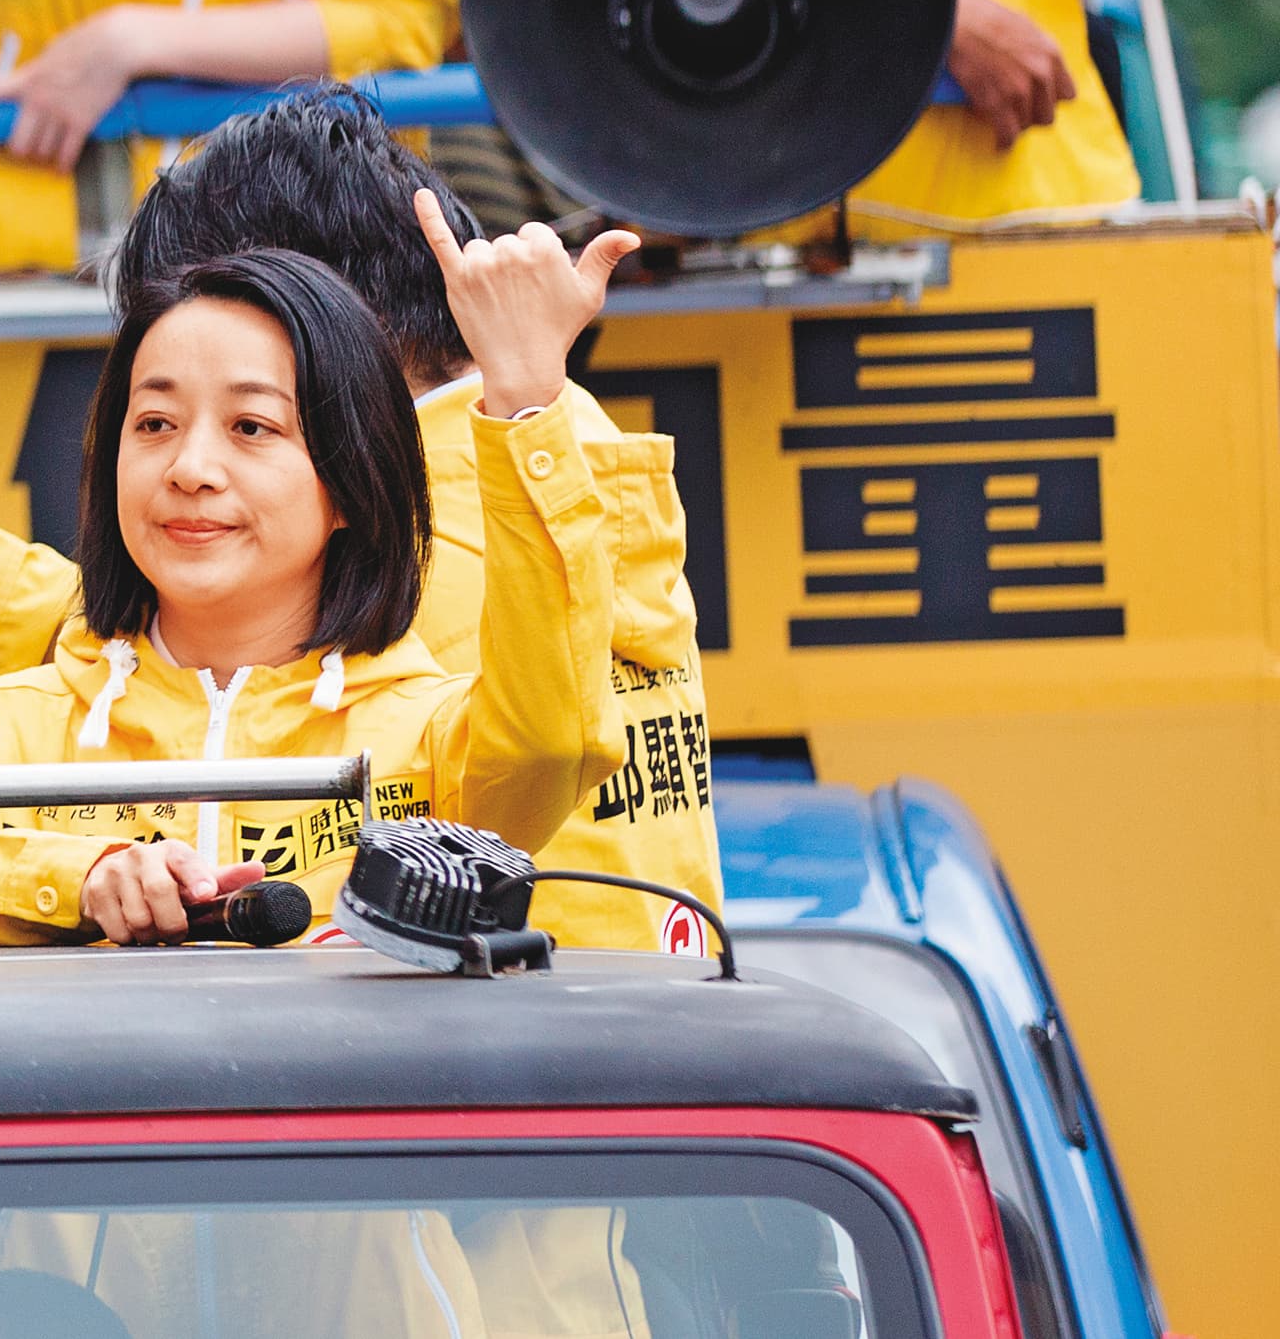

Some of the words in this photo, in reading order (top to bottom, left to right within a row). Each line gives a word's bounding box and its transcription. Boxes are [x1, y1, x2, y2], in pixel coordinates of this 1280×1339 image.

[592, 710, 710, 824] 邱顯智
[375, 782, 414, 802] NEW
[379, 800, 430, 821] POWER
[310, 799, 359, 836] 時代
[313, 821, 360, 859] 力量
